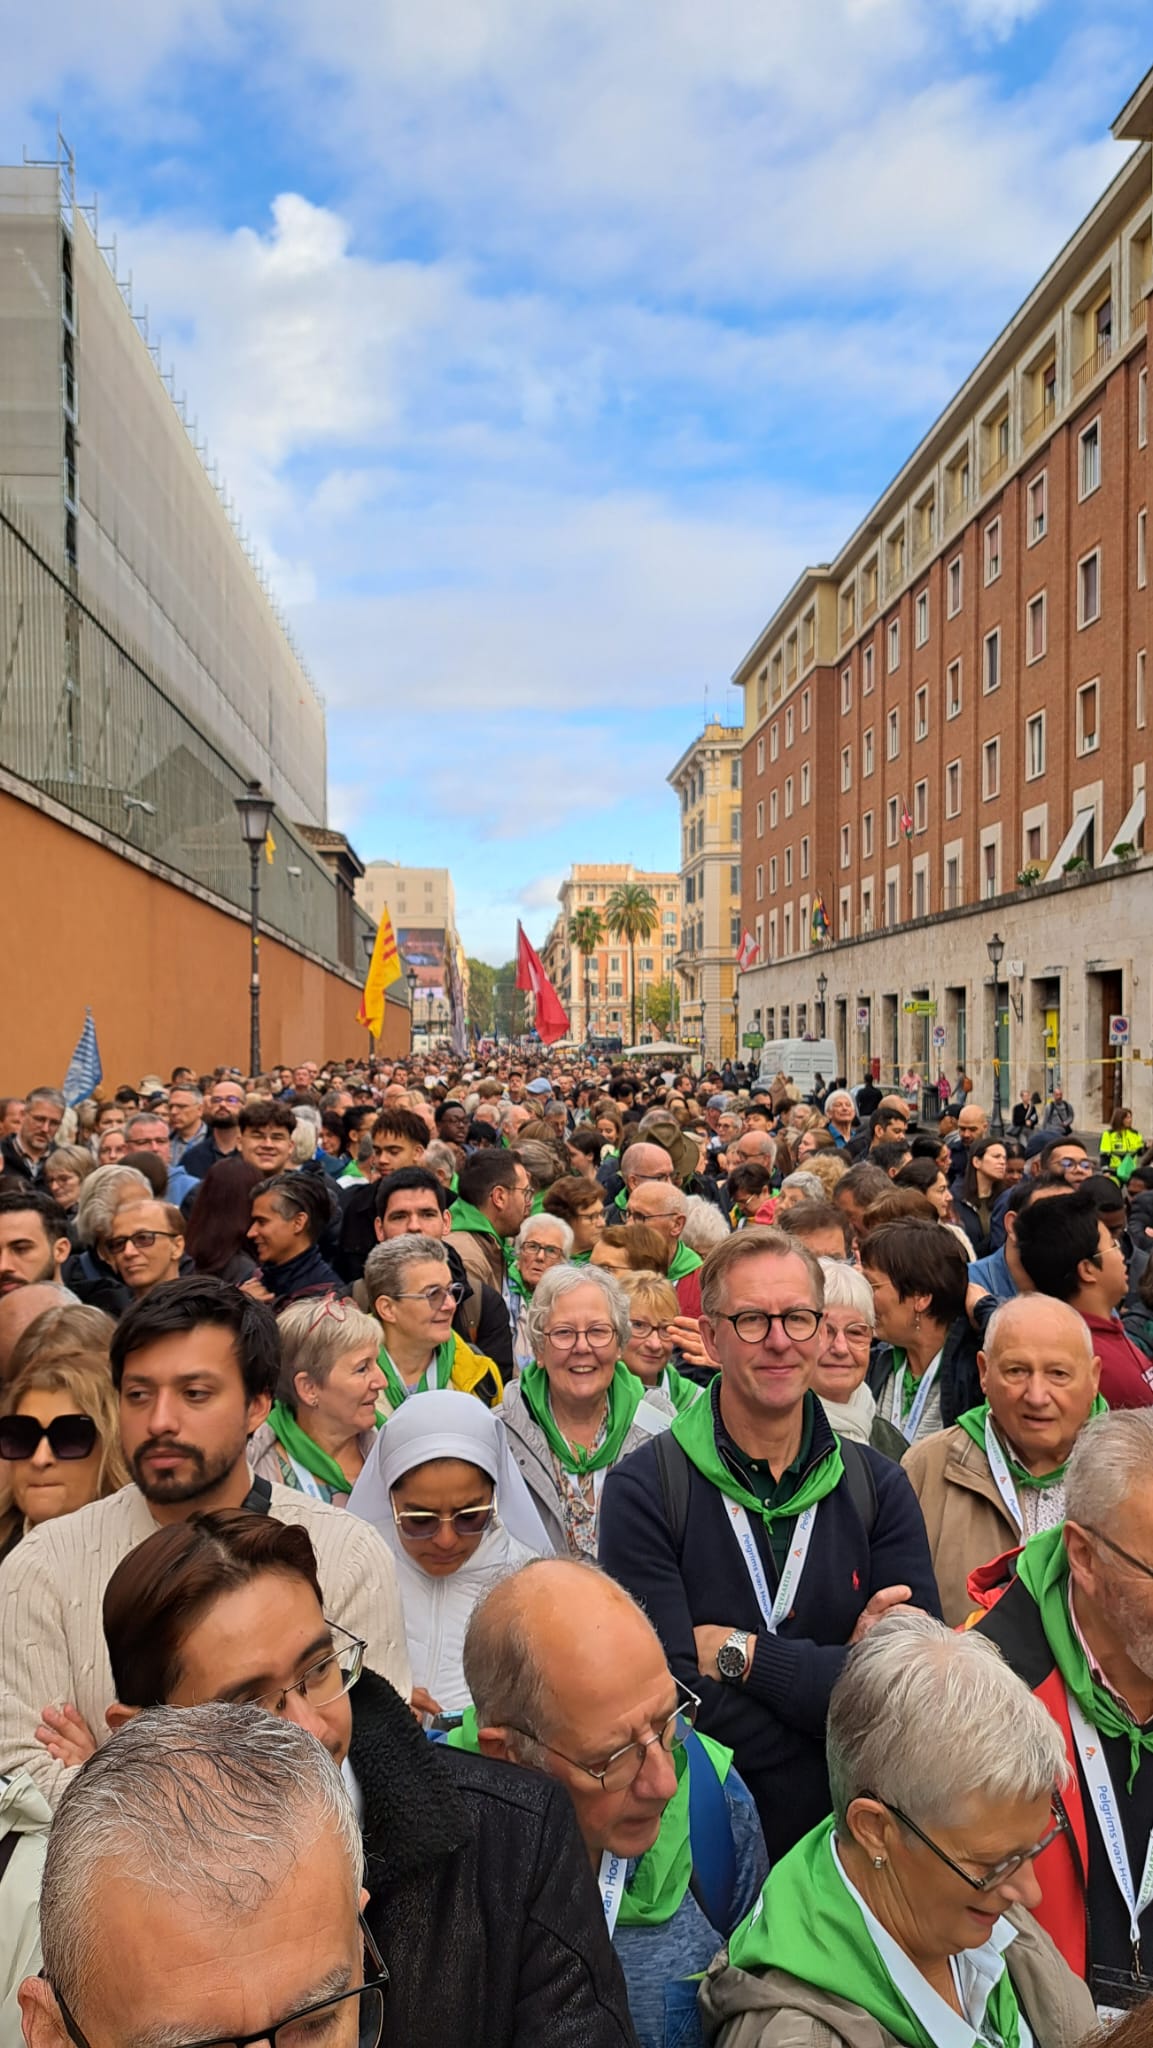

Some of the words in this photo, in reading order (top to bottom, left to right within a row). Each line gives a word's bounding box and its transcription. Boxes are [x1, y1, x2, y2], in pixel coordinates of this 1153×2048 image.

[800, 1506, 812, 1530] Pelg
[742, 1533, 759, 1571] Pelgrims
[1097, 1785, 1117, 1839] Pelgrims
[1112, 1841, 1123, 1865] van
[605, 1858, 619, 1886] Hoo
